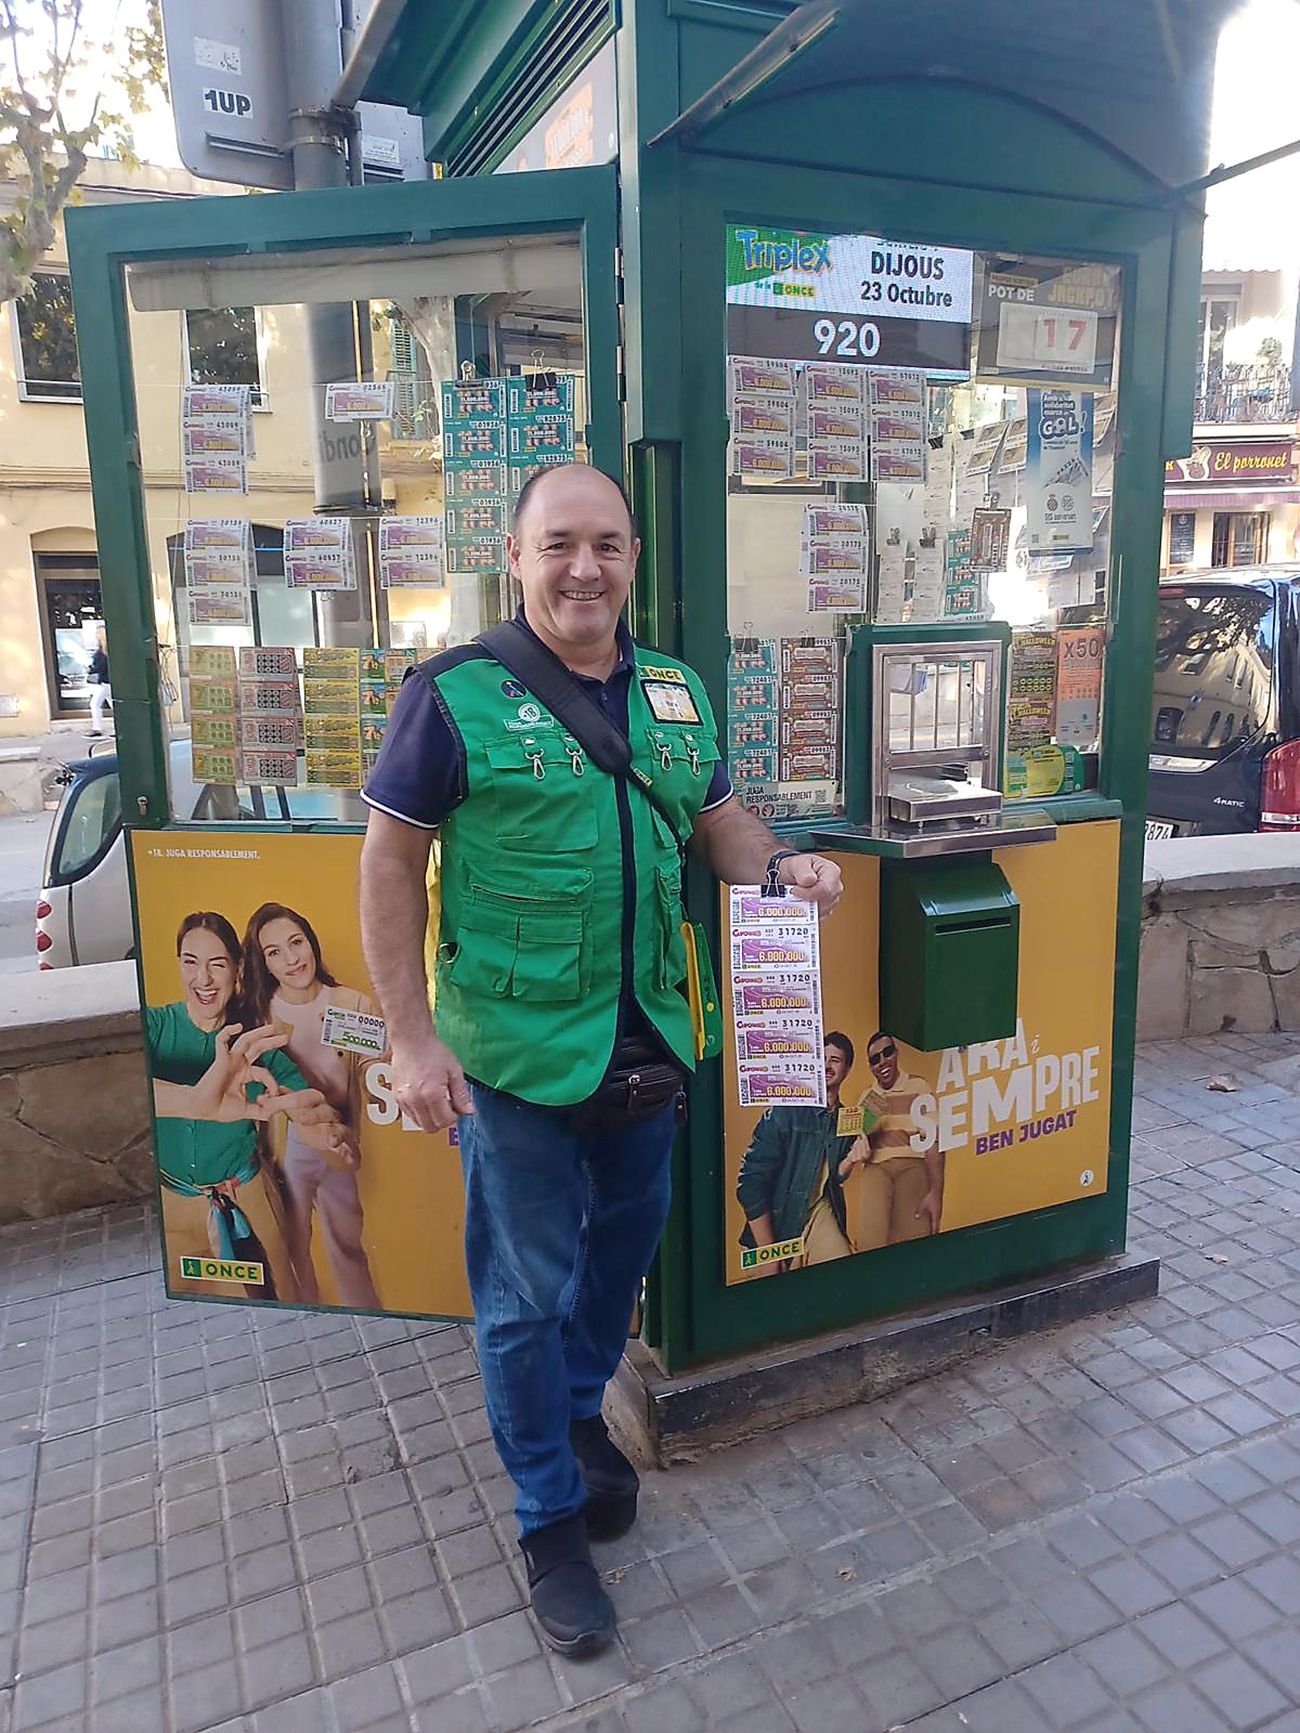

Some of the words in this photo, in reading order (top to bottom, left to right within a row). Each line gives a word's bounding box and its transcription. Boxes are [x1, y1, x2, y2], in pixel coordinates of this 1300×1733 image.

[205, 90, 251, 115] 1UP
[735, 229, 833, 276] Triplex
[871, 251, 944, 280] DIJOUS
[785, 285, 814, 297] ONCE
[861, 280, 881, 301] 23
[887, 283, 952, 307] Octubre
[988, 284, 1014, 299] POT
[1017, 288, 1035, 301] DE
[813, 318, 881, 359] 920
[1214, 451, 1232, 471] El
[1232, 452, 1288, 473] porronet
[1064, 637, 1099, 659] x50
[648, 668, 681, 680] ONCE
[1213, 796, 1245, 808] 4MATIC
[166, 848, 186, 858] JUGA
[758, 907, 803, 916] 6.000.000
[778, 927, 808, 935] 31720
[759, 951, 804, 961] 6.000.000
[780, 974, 810, 982] 31720
[761, 998, 806, 1007] 6.000.000
[782, 1019, 813, 1027] 31720
[764, 1042, 809, 1052] 6.000.000
[785, 1063, 815, 1072] 31720
[767, 1086, 812, 1096] 6.000.000
[909, 1046, 1100, 1153] SEMPRE
[975, 1129, 1014, 1156] BEN
[1019, 1109, 1077, 1143] JUGAT
[760, 1241, 800, 1260] ONCE
[205, 1263, 258, 1280] ONCE
